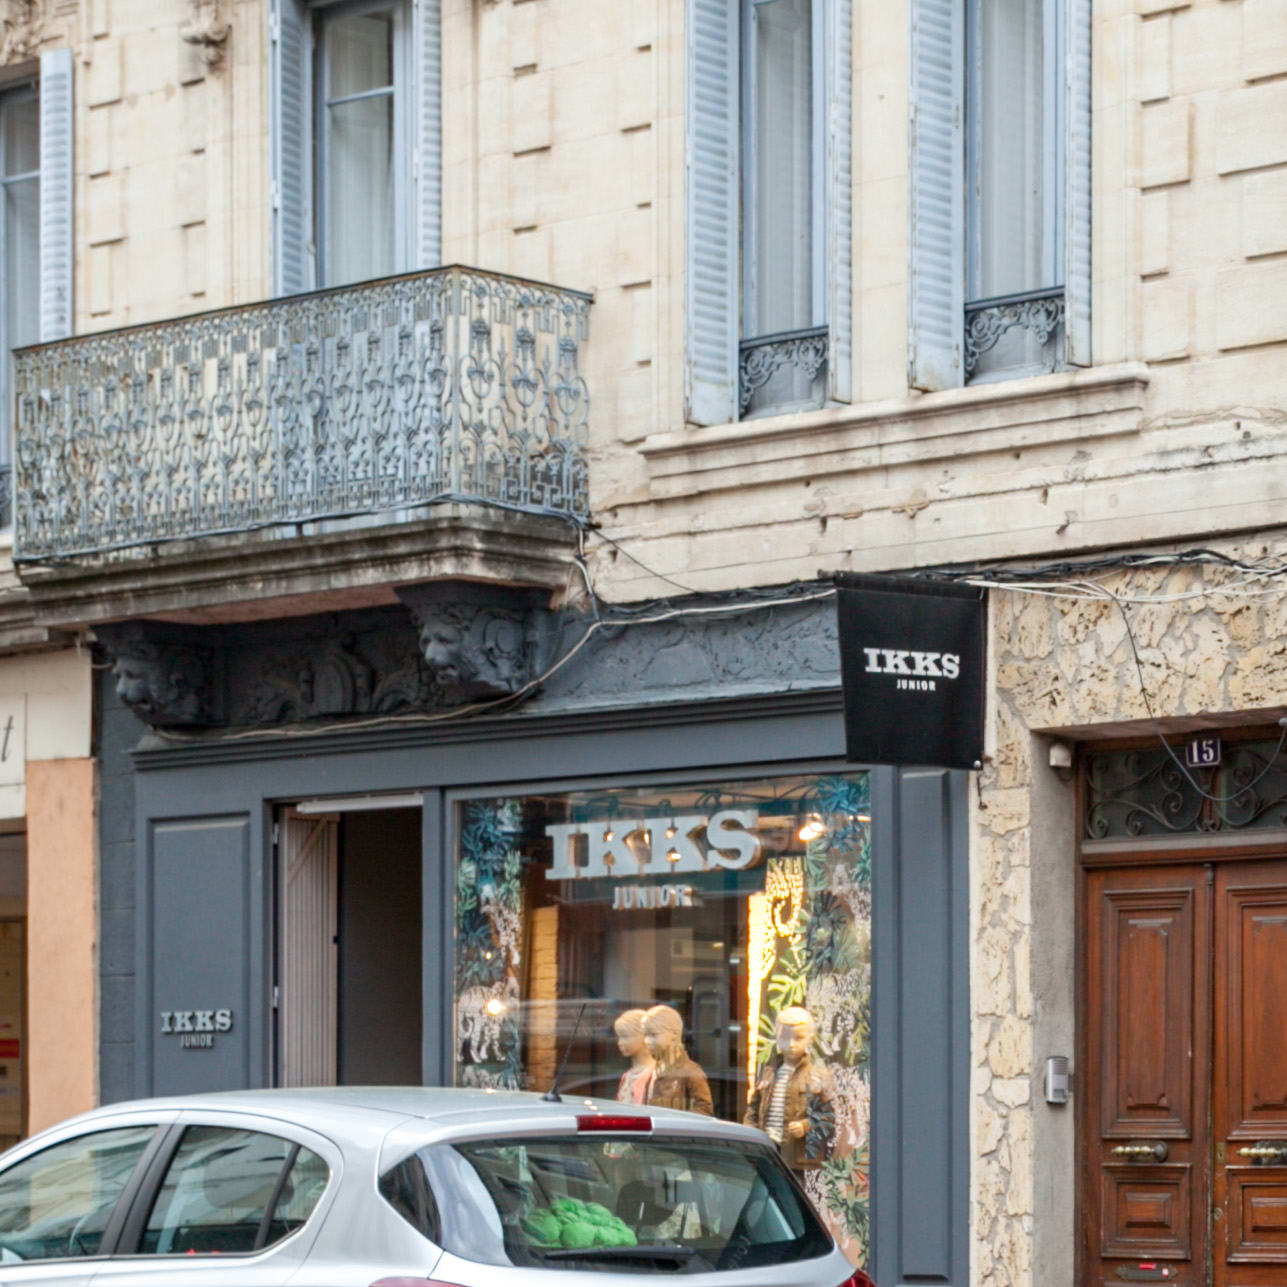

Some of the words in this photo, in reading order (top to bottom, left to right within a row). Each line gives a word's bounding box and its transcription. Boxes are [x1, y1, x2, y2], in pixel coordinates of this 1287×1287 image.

[863, 647, 960, 679] IKKS
[896, 678, 937, 691] JUNIOR
[1191, 739, 1215, 763] 15
[545, 809, 763, 880] IKKS
[612, 884, 694, 910] JUNIOR
[161, 1009, 232, 1032] IKKS
[181, 1033, 213, 1048] JUNIOR
